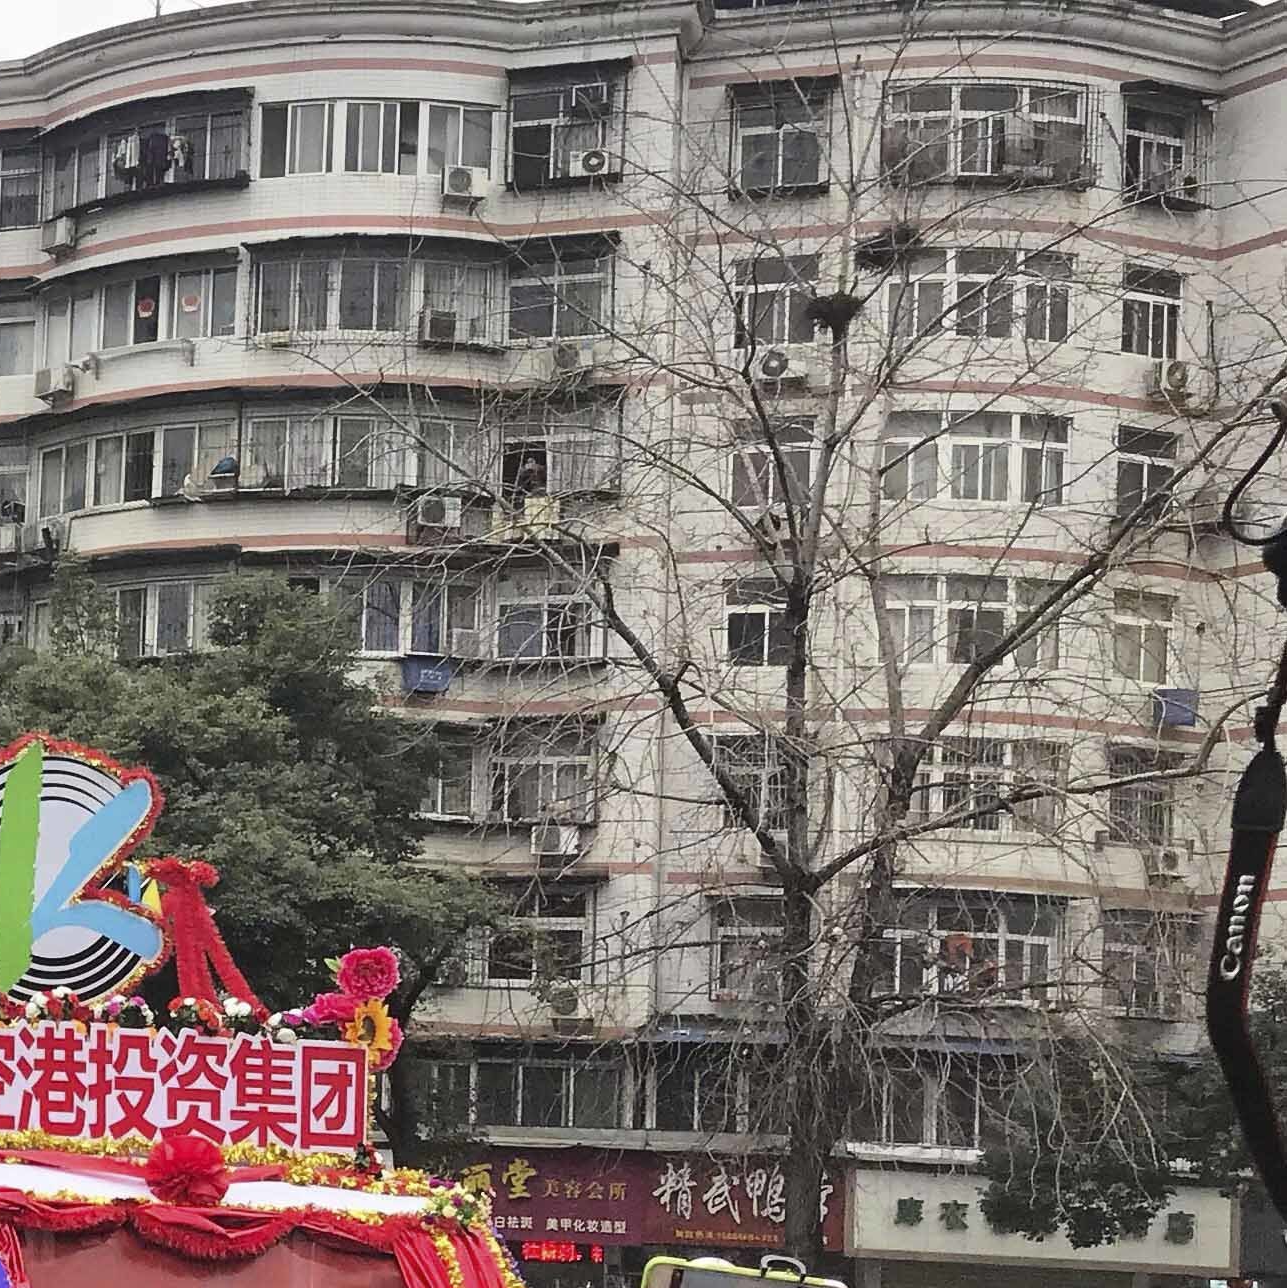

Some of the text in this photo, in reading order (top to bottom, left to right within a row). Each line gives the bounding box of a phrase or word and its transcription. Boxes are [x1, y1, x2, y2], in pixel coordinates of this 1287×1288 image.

[1220, 874, 1256, 981] Canon
[541, 1178, 628, 1201] 美容会所
[545, 1216, 627, 1235] 美甲化妆造型
